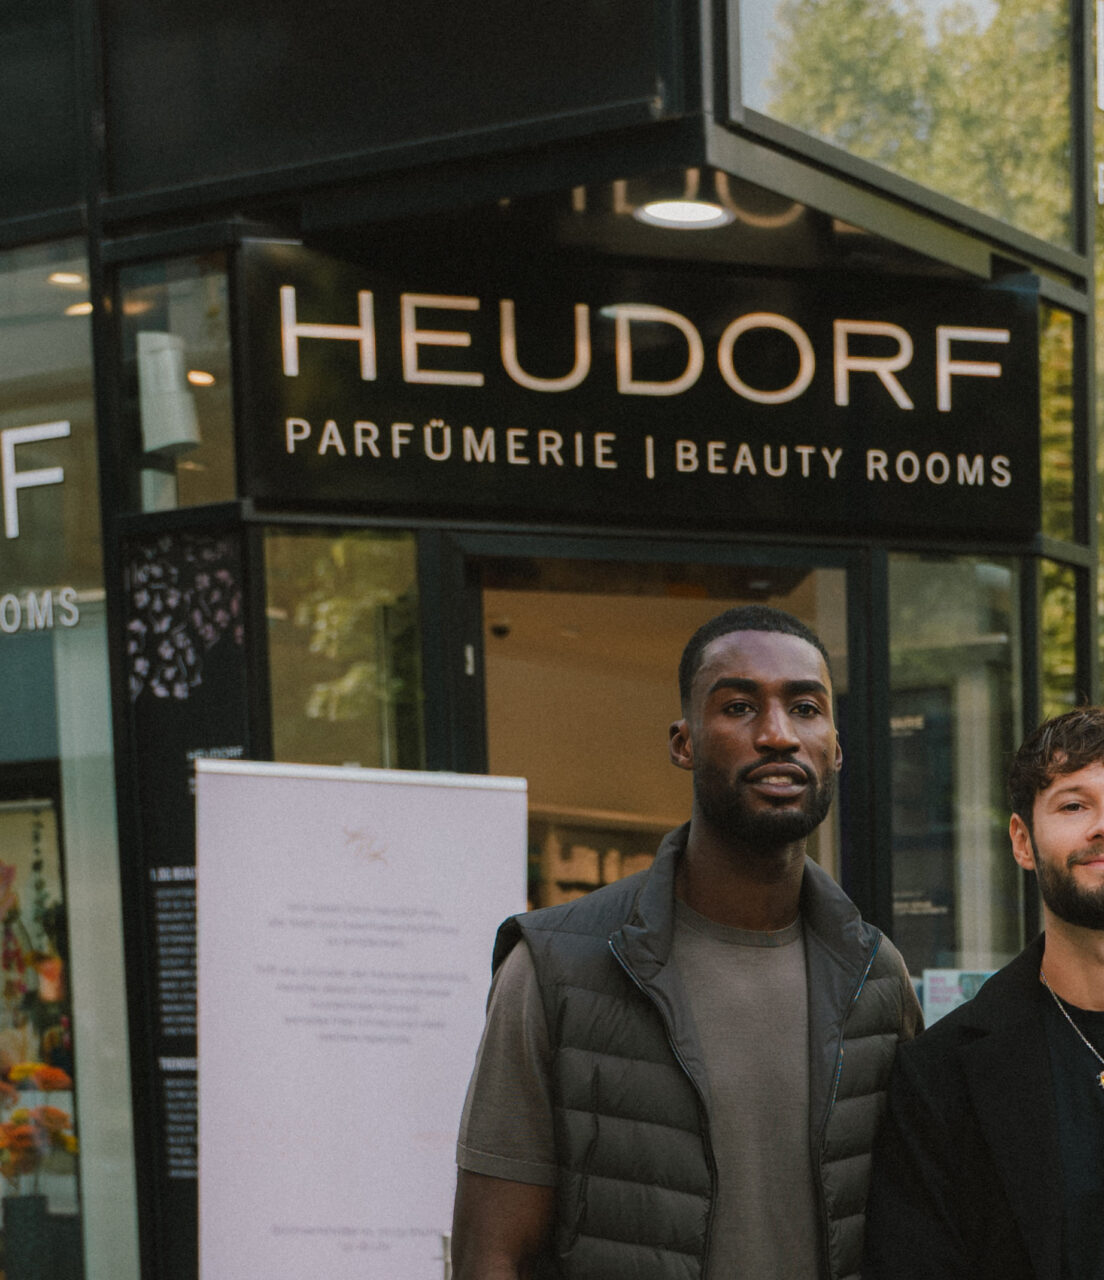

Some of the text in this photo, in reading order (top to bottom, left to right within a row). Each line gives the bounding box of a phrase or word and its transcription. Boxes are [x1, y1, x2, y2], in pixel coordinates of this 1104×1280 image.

[280, 285, 1011, 412] HEUDORF
[285, 417, 618, 469] PARFÜMERIE
[675, 439, 843, 479] BEAUTY
[866, 449, 1012, 488] ROOMS
